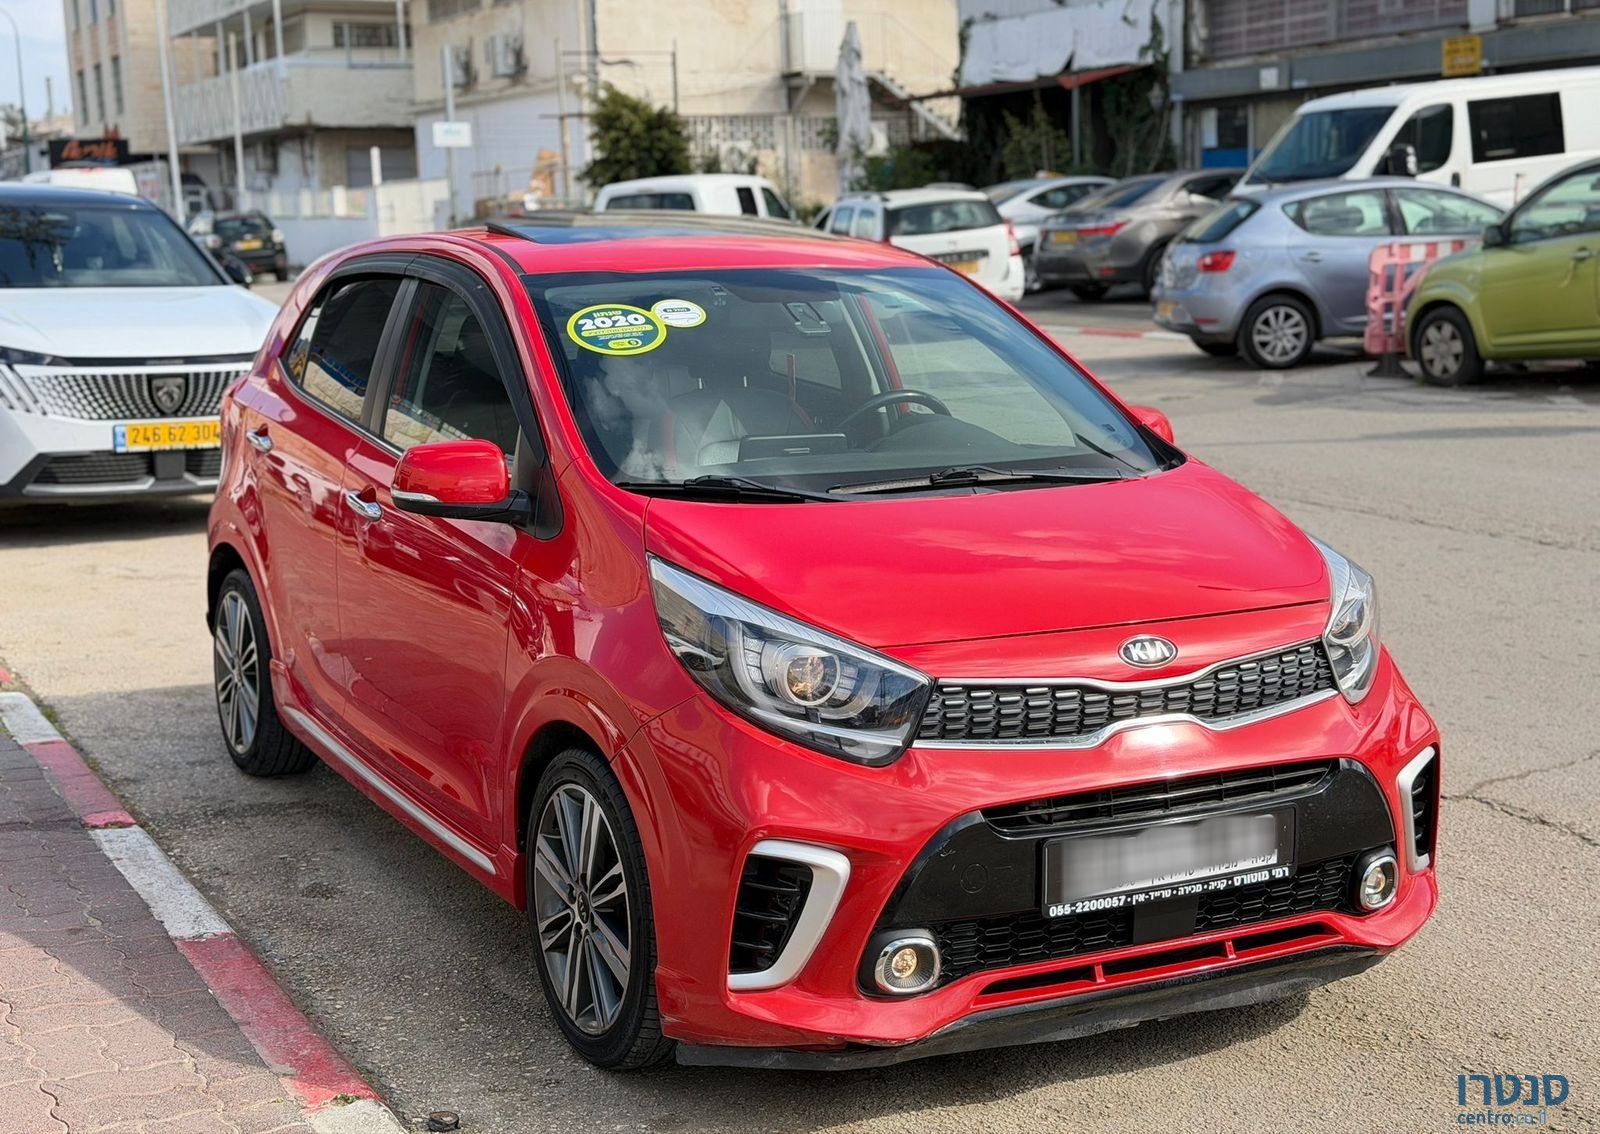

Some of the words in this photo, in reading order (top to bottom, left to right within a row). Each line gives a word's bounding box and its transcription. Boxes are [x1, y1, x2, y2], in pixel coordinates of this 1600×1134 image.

[578, 313, 646, 331] 2020
[1127, 641, 1170, 661] KIA
[1233, 870, 1270, 887] מוטורס
[1272, 867, 1289, 879] רמי
[1178, 884, 1202, 896] מכירה
[1208, 879, 1228, 891] קניה
[1049, 896, 1126, 917] 055-2200057
